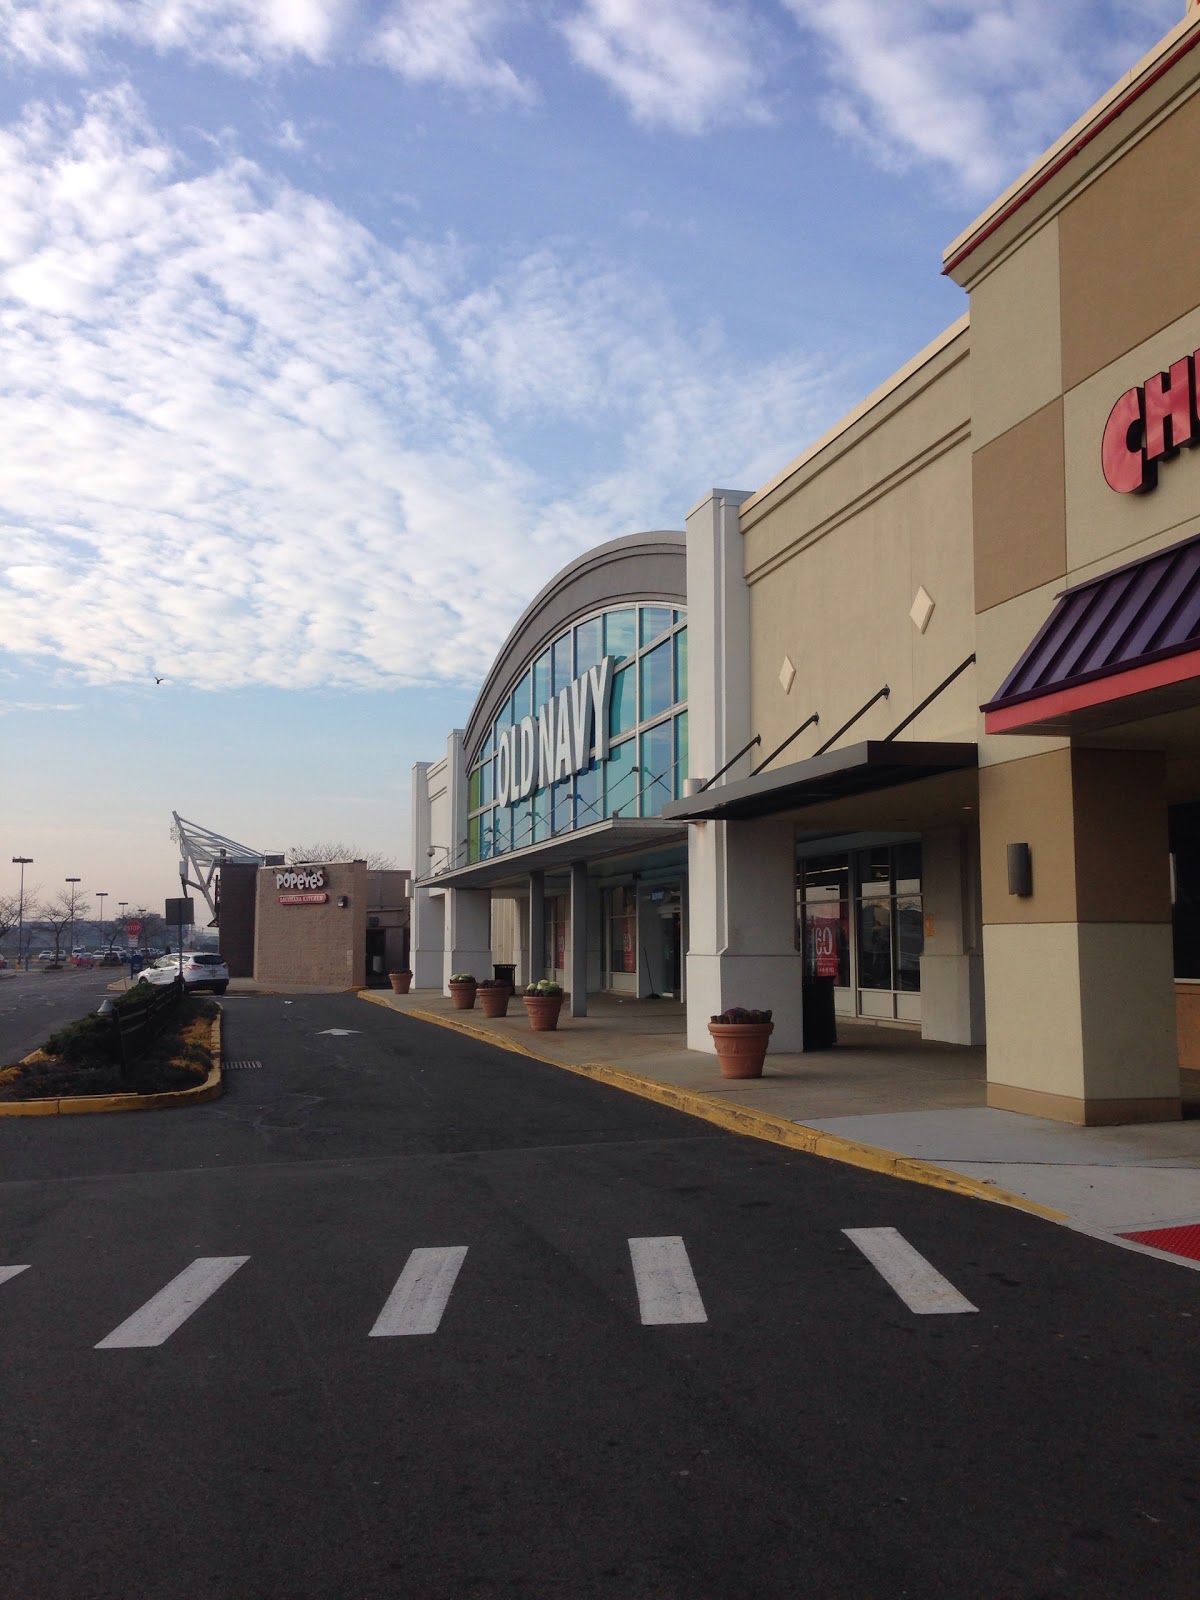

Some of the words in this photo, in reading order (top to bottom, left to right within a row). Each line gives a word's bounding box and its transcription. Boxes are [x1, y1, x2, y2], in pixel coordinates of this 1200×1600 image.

[1102, 348, 1200, 494] CH
[500, 715, 538, 808] OLD
[539, 655, 615, 789] NAVY
[127, 924, 141, 932] STOP
